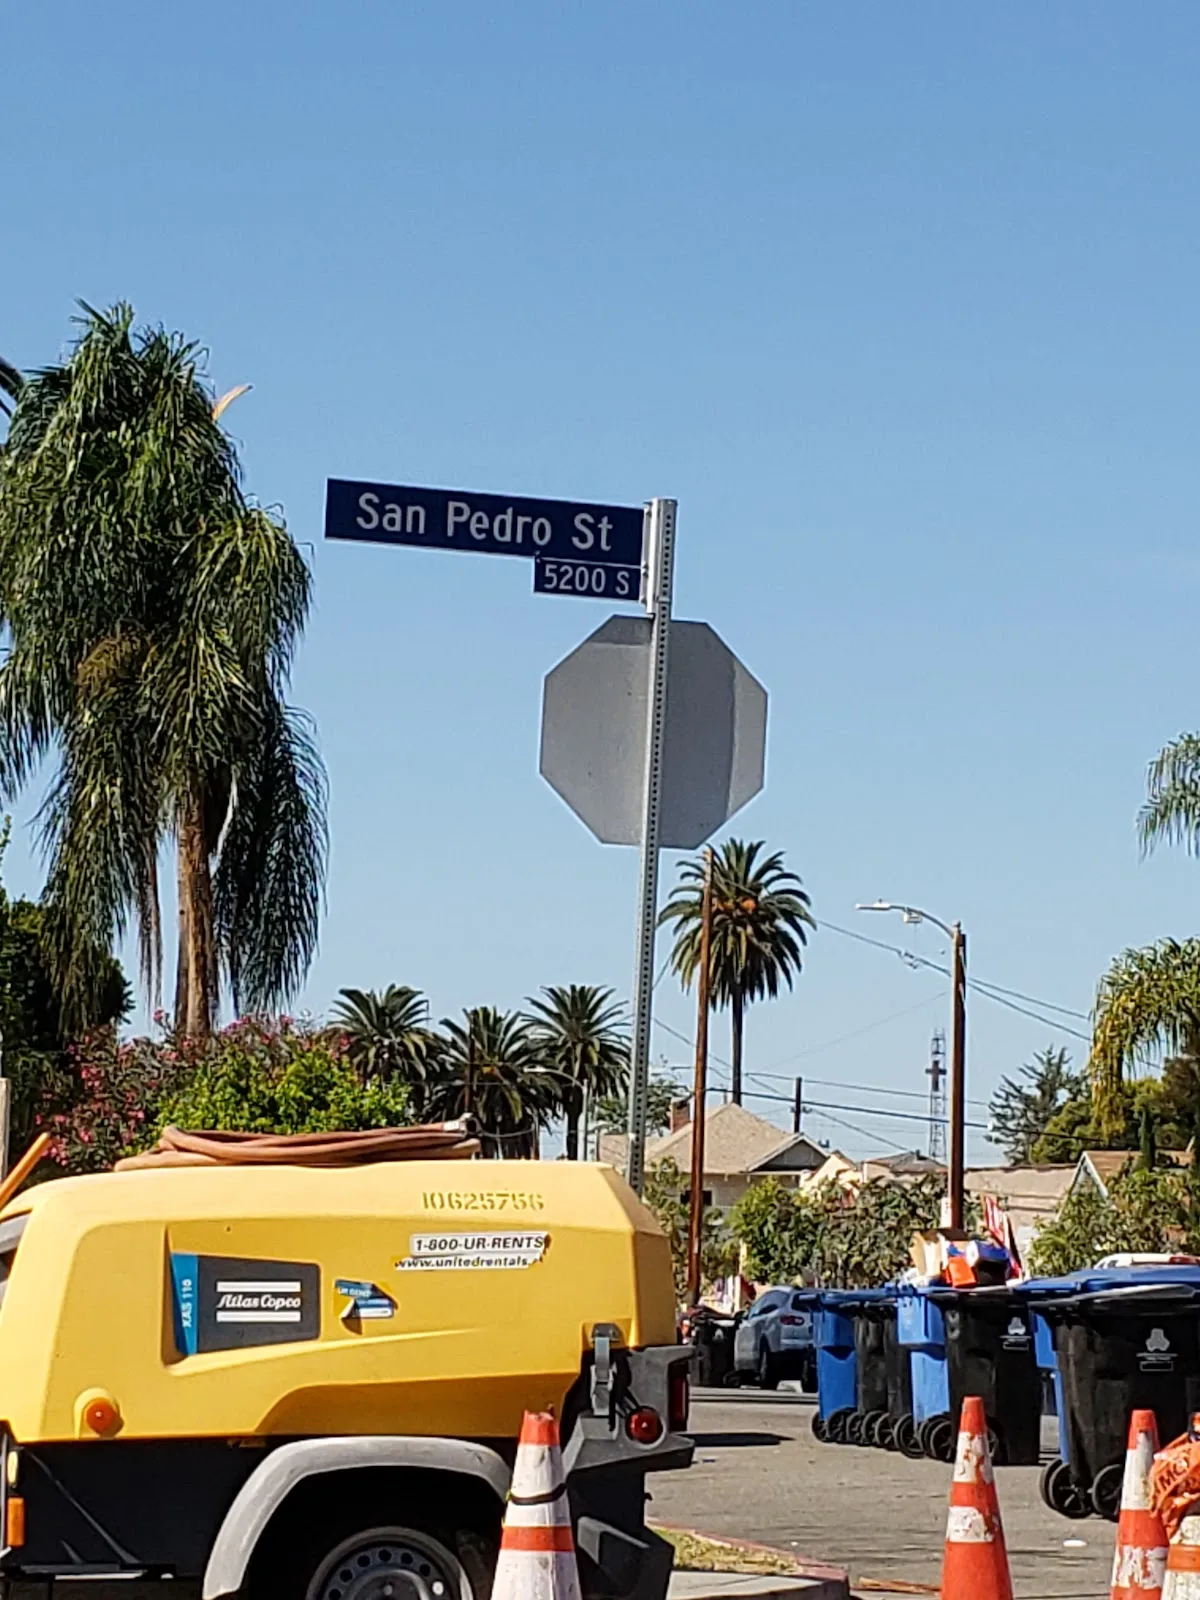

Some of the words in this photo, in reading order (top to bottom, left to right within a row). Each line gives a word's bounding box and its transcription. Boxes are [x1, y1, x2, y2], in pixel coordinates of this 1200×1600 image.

[356, 492, 426, 534] San
[447, 501, 552, 546] Pedro
[572, 513, 614, 551] St
[544, 564, 606, 593] 5200
[616, 570, 630, 595] S
[422, 1192, 544, 1210] 10625756
[216, 1294, 260, 1309] Atlas
[261, 1294, 301, 1311] Copco
